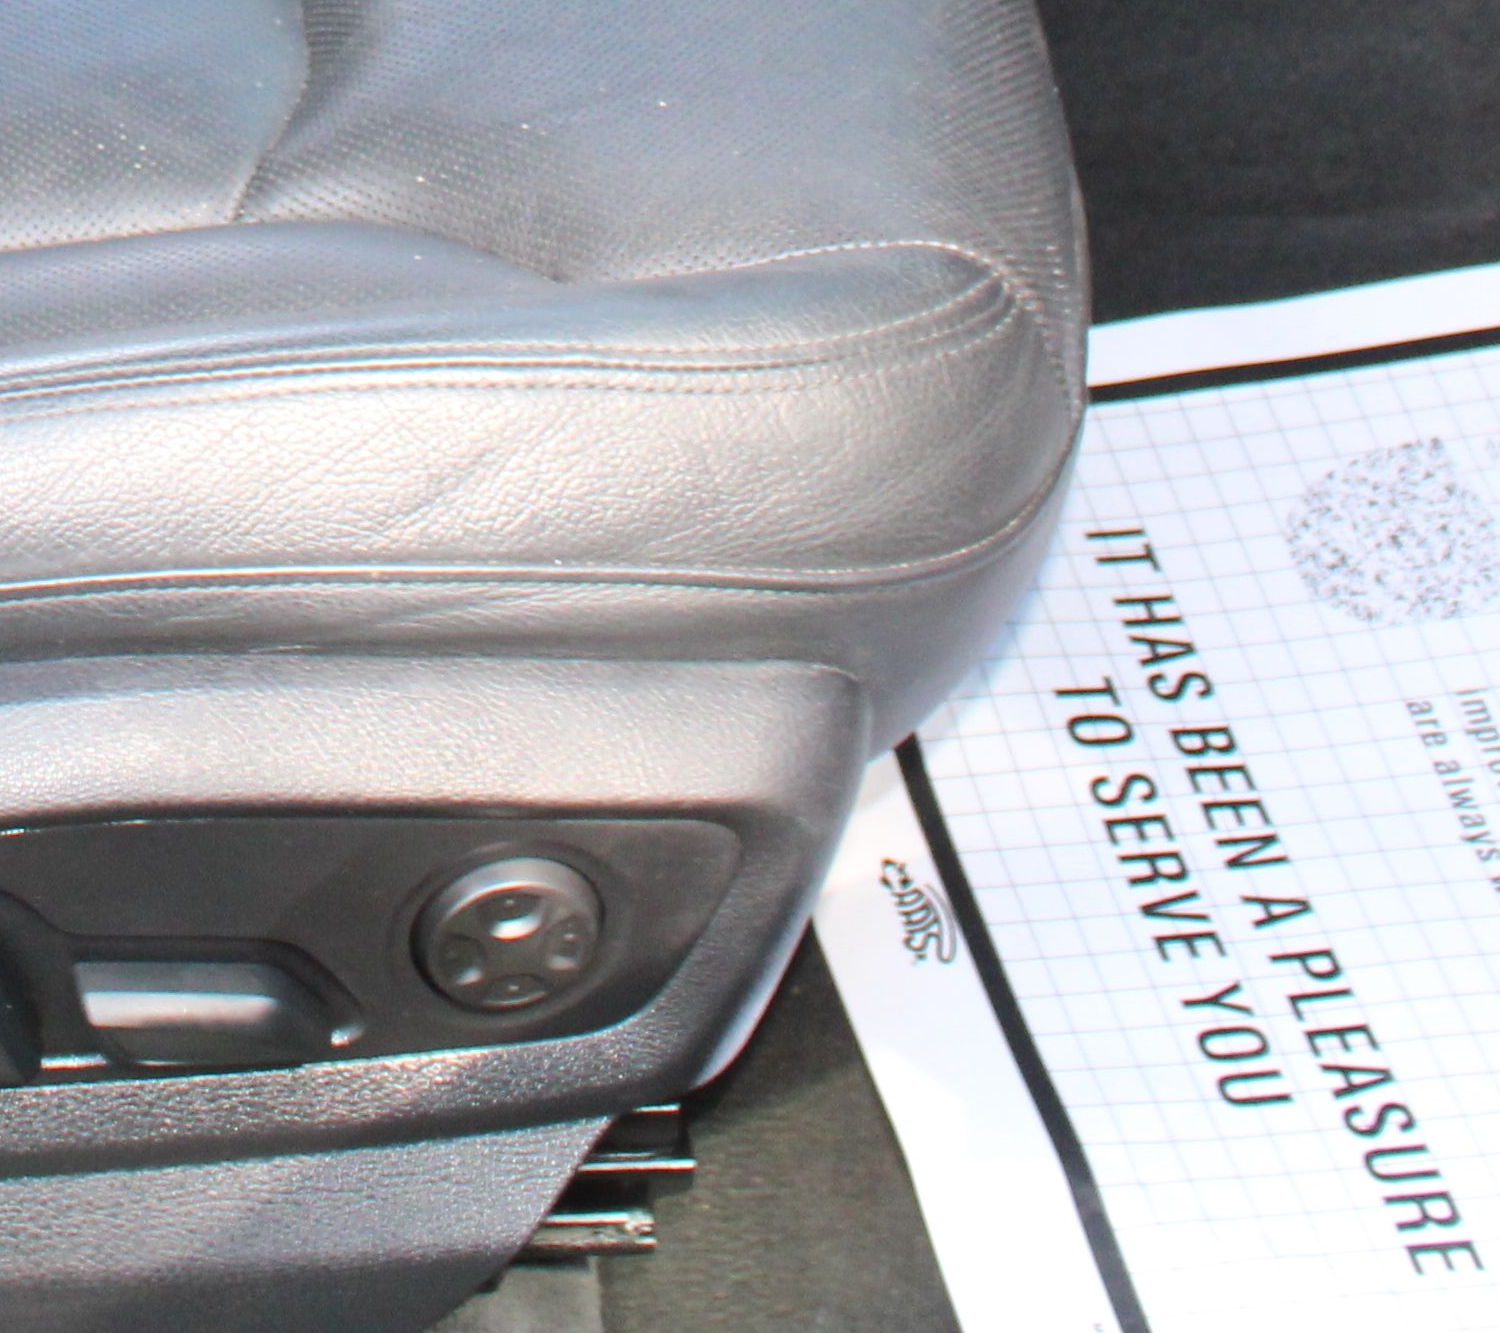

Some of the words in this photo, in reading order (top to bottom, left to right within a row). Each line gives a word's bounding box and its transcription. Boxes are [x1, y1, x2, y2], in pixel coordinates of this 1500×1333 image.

[1085, 528, 1161, 573] IT
[1113, 594, 1212, 701] HAS
[1053, 676, 1136, 747] TO
[1405, 699, 1448, 746] are
[1170, 727, 1289, 869] BEEN
[1088, 773, 1226, 961] SERVE
[1240, 897, 1311, 928] A
[1181, 983, 1292, 1109] YOU
[1268, 949, 1486, 1275] PLEASURE
